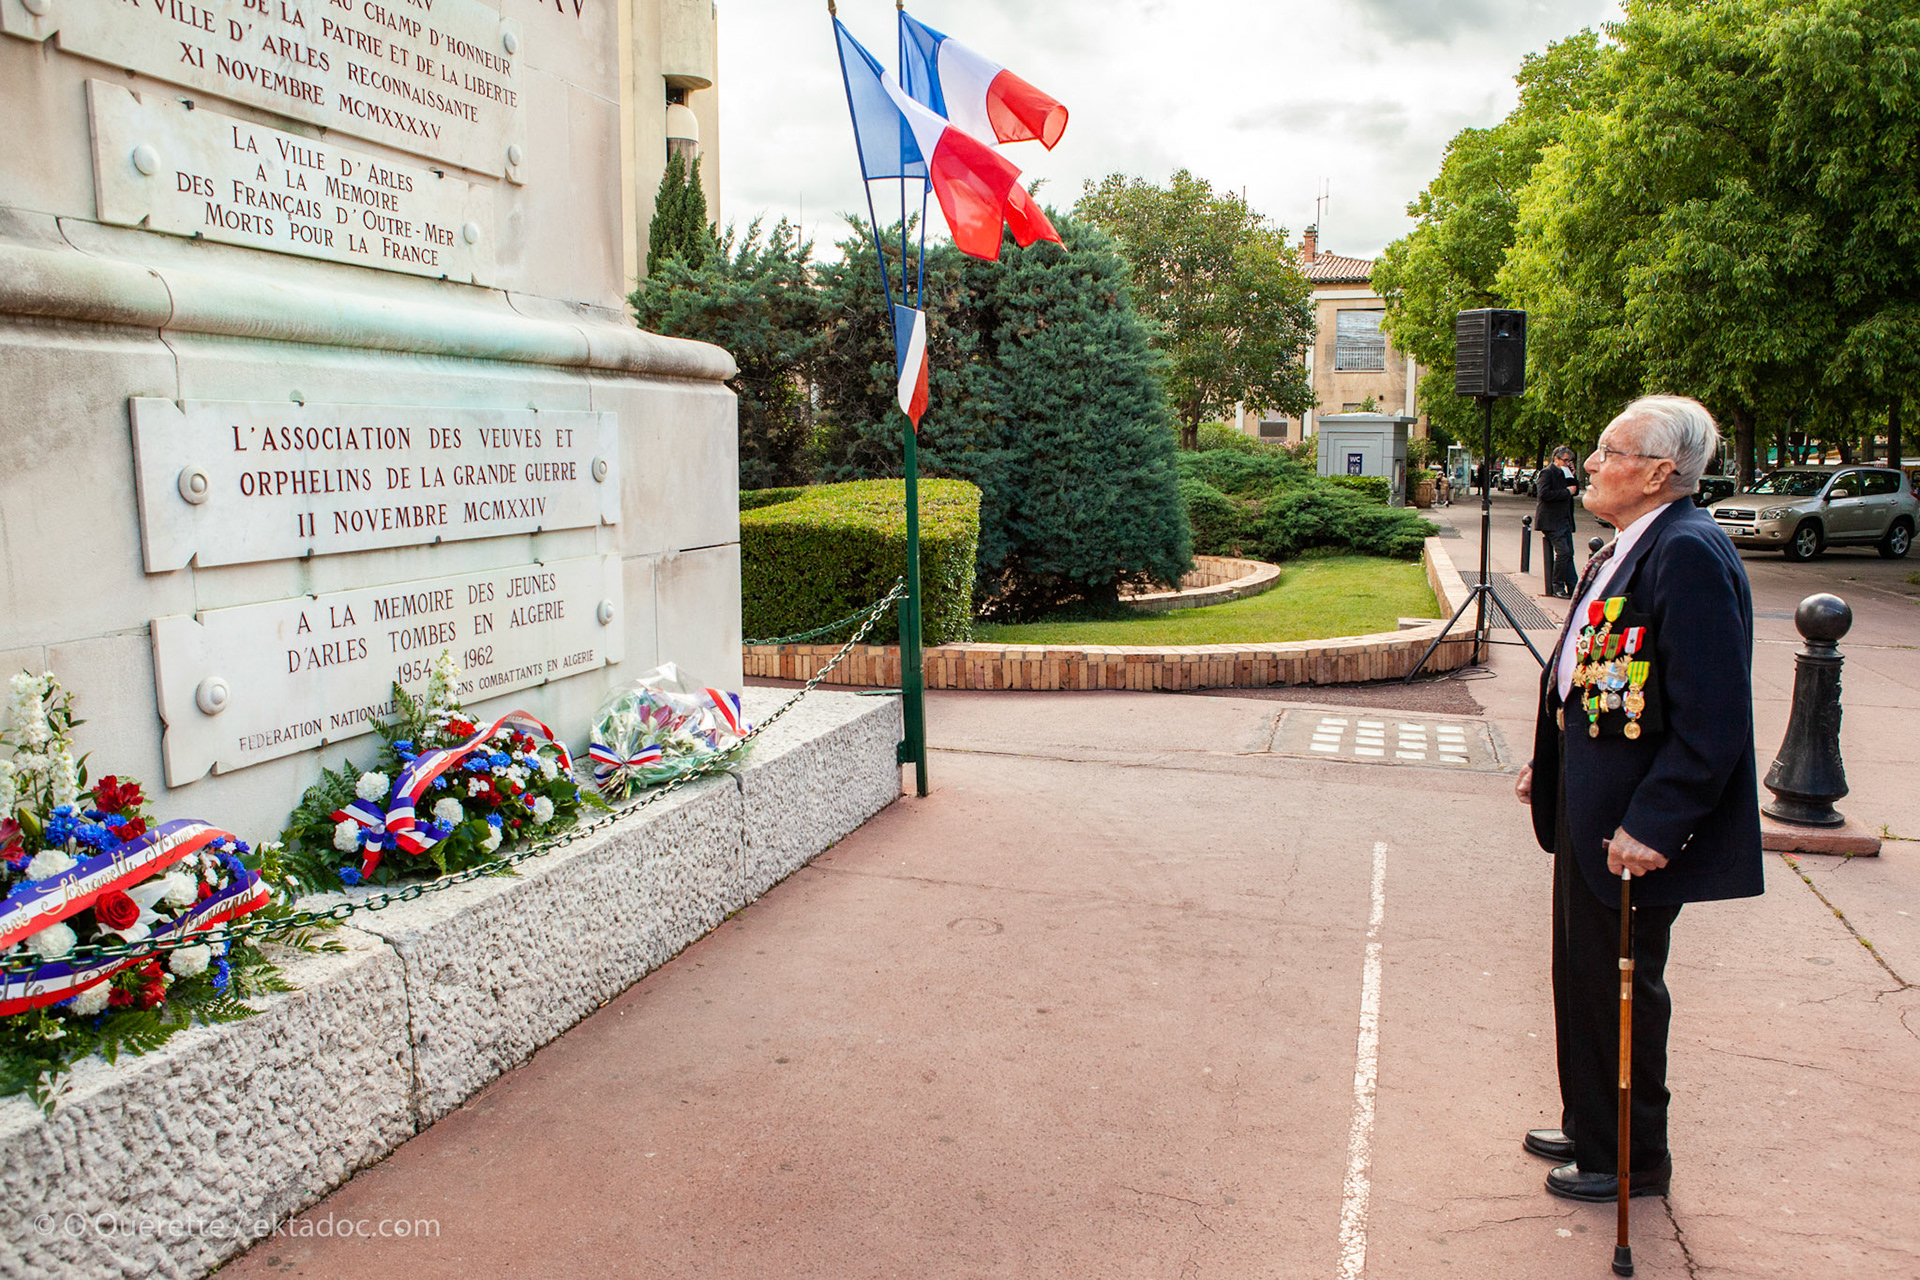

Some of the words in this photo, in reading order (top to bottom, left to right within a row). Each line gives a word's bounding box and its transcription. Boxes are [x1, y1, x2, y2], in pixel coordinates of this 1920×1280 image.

[154, 0, 216, 33] VILLE
[347, 62, 479, 123] RECONNAISSANTE
[281, 1, 305, 28] LA
[322, 17, 383, 58] PATRIE
[390, 44, 409, 67] ET
[416, 54, 435, 77] DE
[441, 64, 458, 86] LA
[464, 74, 518, 108] LIBERTE
[364, 2, 421, 38] CHAMP
[429, 28, 511, 78] D'HONNEUR
[179, 41, 205, 69] XI
[215, 54, 325, 105] NOVEMBRE
[339, 93, 441, 140] MCMXXXXV
[232, 126, 258, 154] LA
[276, 137, 326, 170] VILLE
[176, 171, 214, 197] DES
[256, 163, 267, 182] A
[285, 170, 307, 191] LA
[325, 176, 399, 212] MEMOIRE
[205, 202, 274, 236] MORTS
[290, 222, 333, 248] POUR
[349, 234, 368, 254] LA
[382, 237, 439, 266] FRANCE
[232, 426, 411, 451] L'ASSOCIATION
[429, 428, 461, 449] DES
[479, 428, 542, 448] VEUVES
[556, 429, 573, 448] ET
[240, 468, 372, 497] ORPHELINS
[387, 467, 411, 490] DE
[421, 466, 445, 488] LA
[453, 464, 517, 486] GRANDE
[525, 462, 576, 482] GUERRE
[334, 504, 448, 535] NOVEMBRE
[463, 497, 547, 524] MCMXXIV
[297, 612, 311, 635] A
[329, 604, 356, 629] LA
[373, 589, 454, 622] MEMOIRE
[468, 582, 494, 605] DES
[506, 573, 556, 599] JEUNES
[287, 637, 367, 674] D'ARLES
[388, 622, 456, 653] TOMBES
[474, 612, 493, 635] EN
[510, 600, 565, 629] ALGERIE
[398, 658, 432, 684] 1954
[464, 645, 493, 670] 1962
[239, 718, 322, 752] FEDERATION
[330, 699, 398, 731] NATIONALE
[479, 662, 542, 690] COMBATTANTS
[547, 658, 558, 672] EN
[563, 649, 594, 669] ALGERIE
